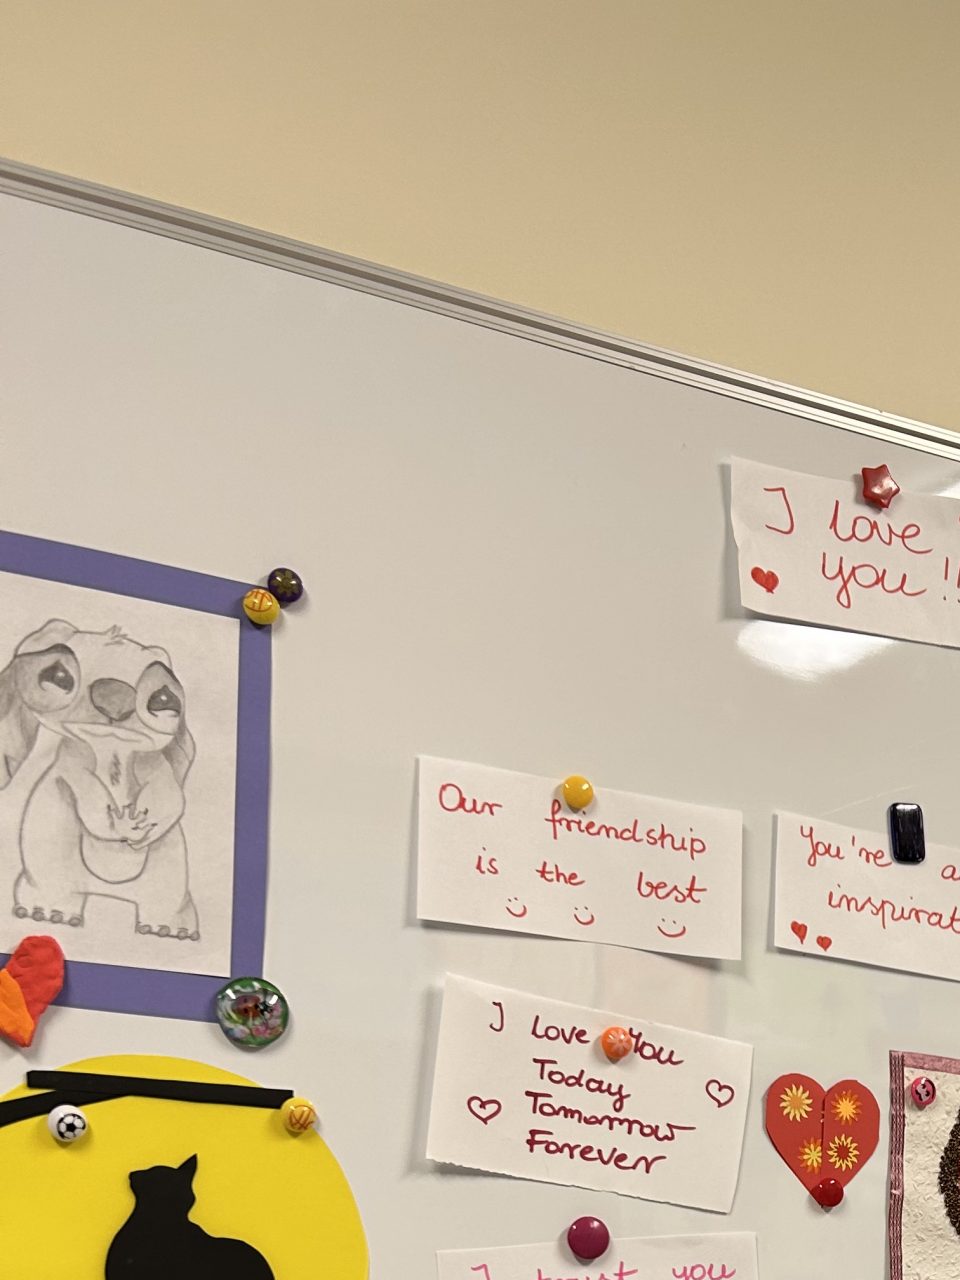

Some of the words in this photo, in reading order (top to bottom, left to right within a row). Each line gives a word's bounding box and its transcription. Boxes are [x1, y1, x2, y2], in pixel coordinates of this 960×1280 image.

[763, 487, 795, 535] I
[830, 500, 932, 554] love
[439, 783, 502, 815] Our
[544, 799, 707, 860] friendship
[800, 825, 892, 868] You're
[475, 847, 499, 875] is
[536, 861, 585, 886] the
[637, 871, 707, 903] best
[490, 1002, 504, 1031] I
[532, 1058, 630, 1112] Today
[525, 1090, 696, 1141] Tomorrow
[526, 1129, 666, 1174] Forever
